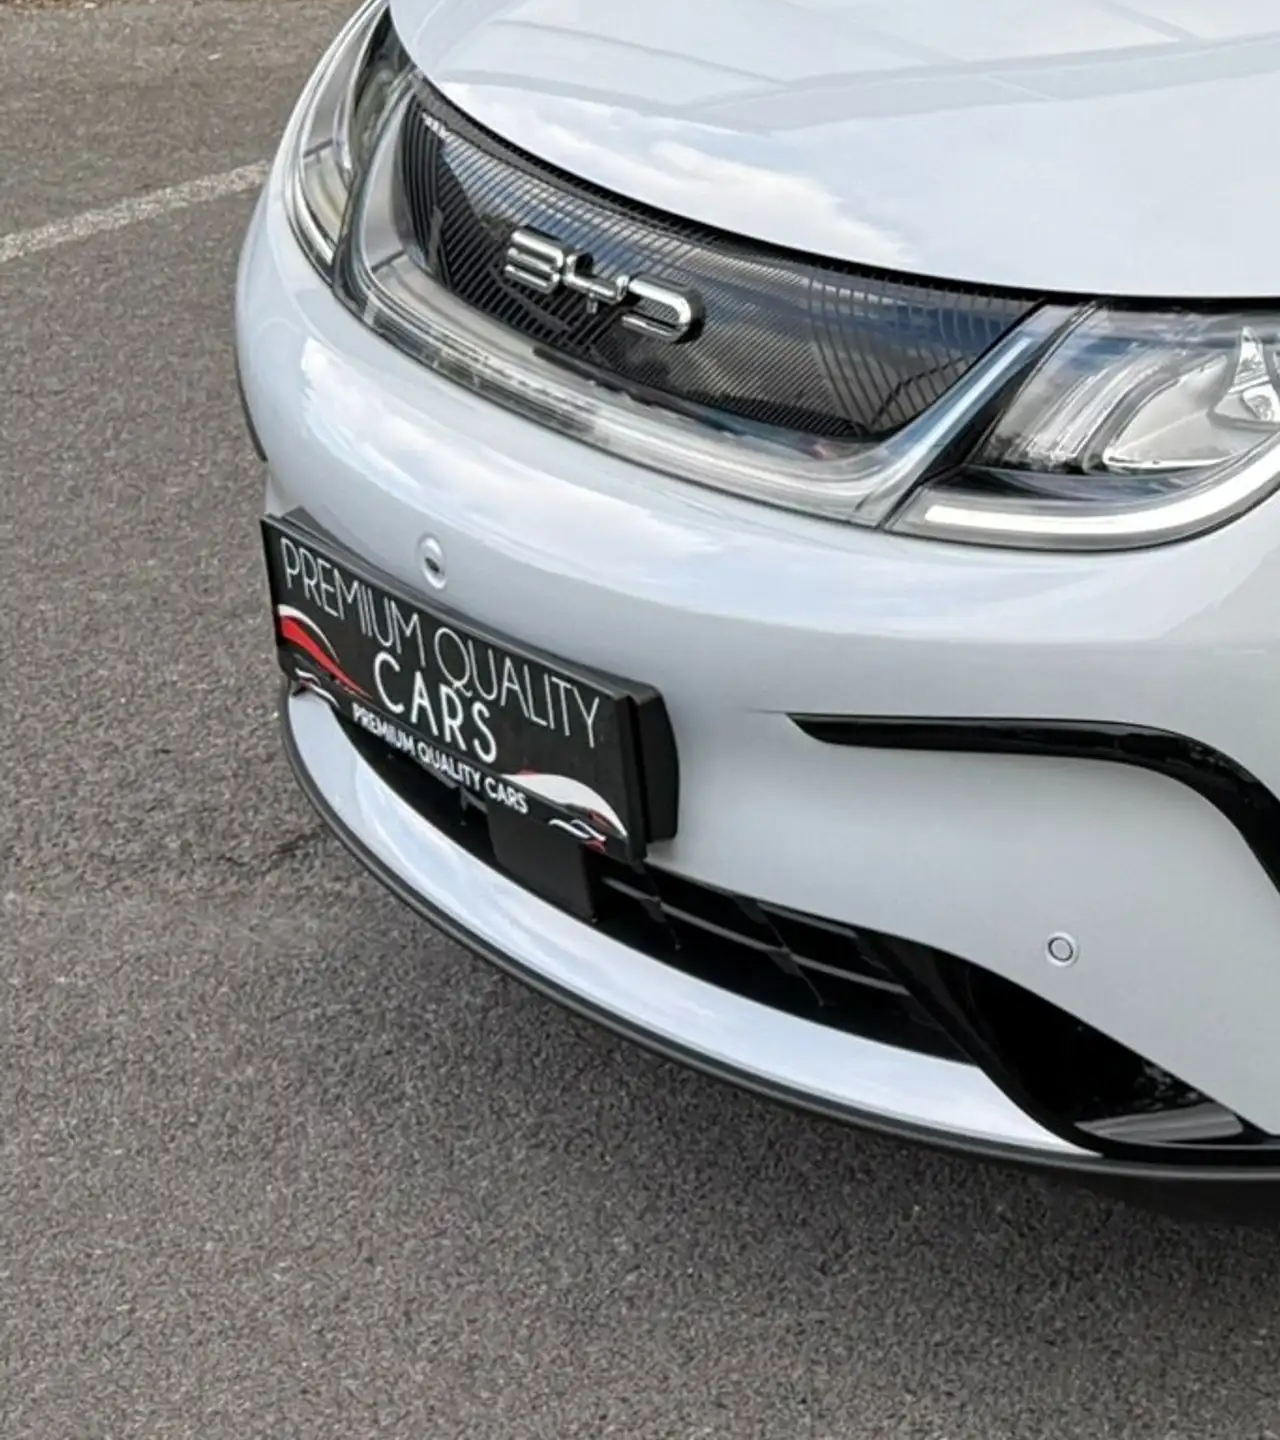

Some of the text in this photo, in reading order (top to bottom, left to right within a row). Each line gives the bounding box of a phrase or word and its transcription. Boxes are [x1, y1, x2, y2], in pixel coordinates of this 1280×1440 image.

[504, 228, 693, 342] BYD
[280, 536, 600, 750] PREMIUM QUALITY
[351, 701, 530, 815] PREMIUM QUALITY CARS
[373, 651, 498, 764] CARS
